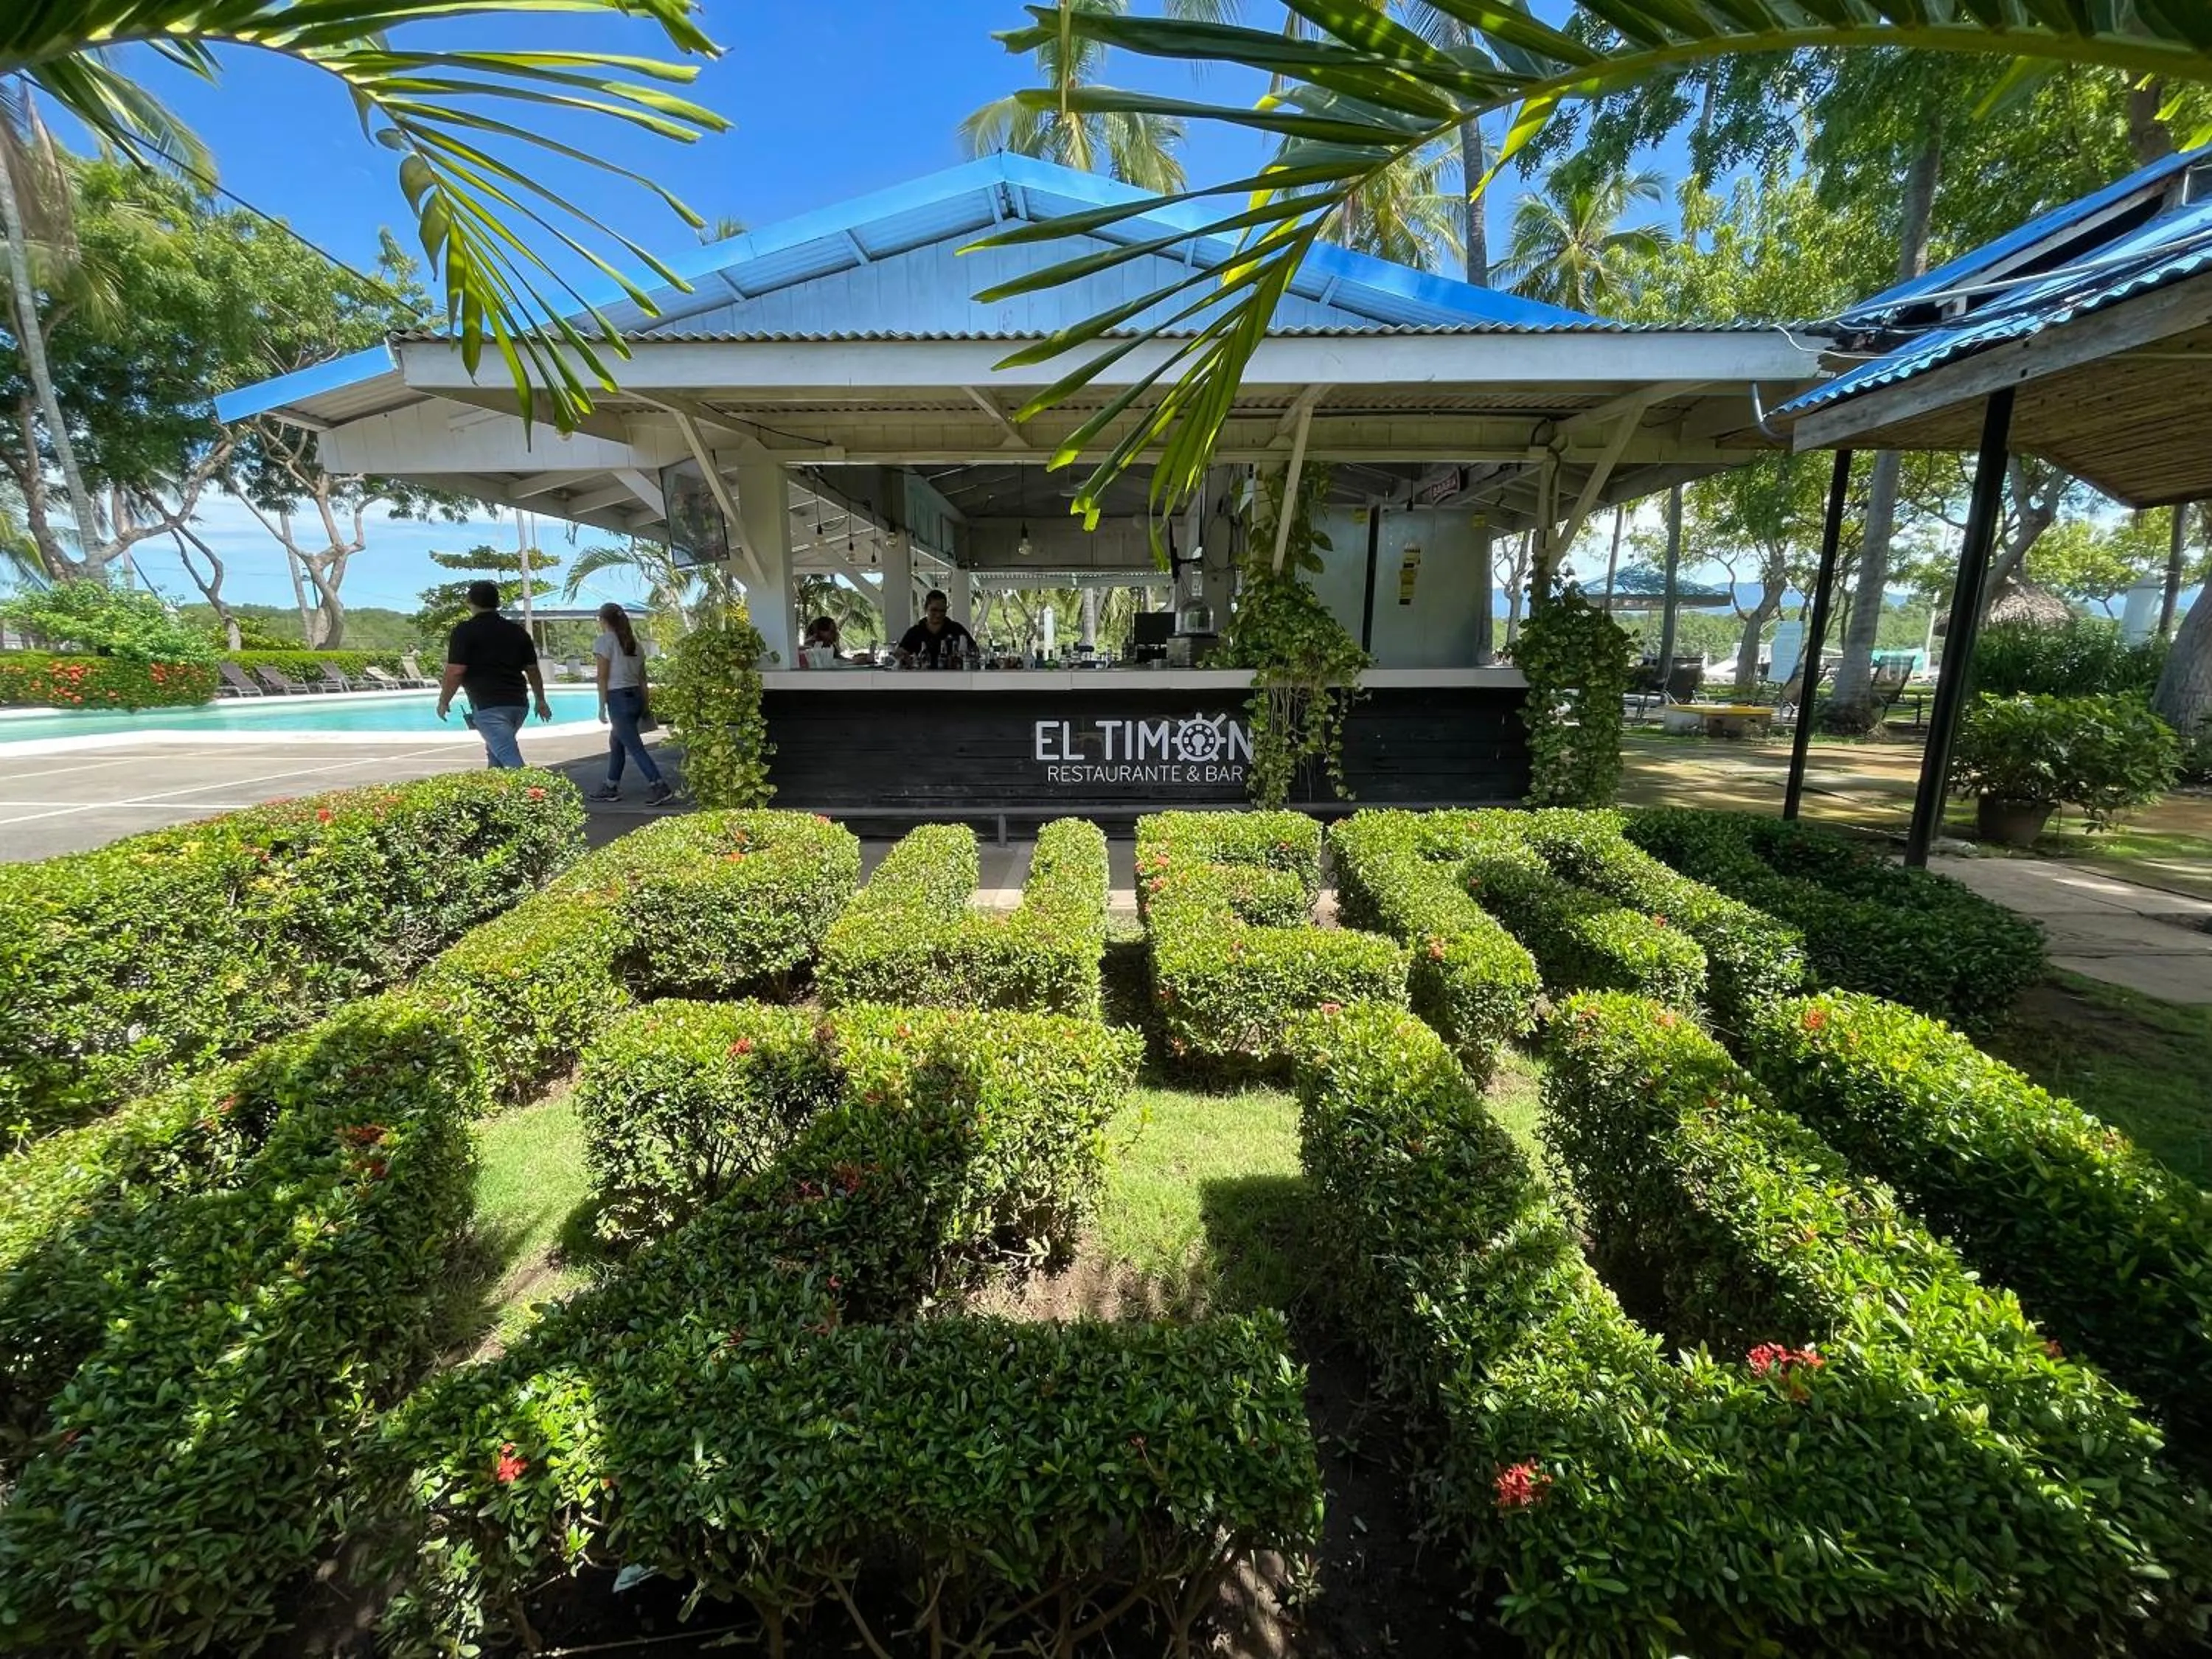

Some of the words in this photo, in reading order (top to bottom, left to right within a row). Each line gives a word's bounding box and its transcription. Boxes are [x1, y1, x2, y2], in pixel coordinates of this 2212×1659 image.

[1035, 720, 1085, 760] EL
[1047, 765, 1182, 782] RESTAURANTE
[1186, 765, 1200, 782] &
[1205, 765, 1244, 782] BAR
